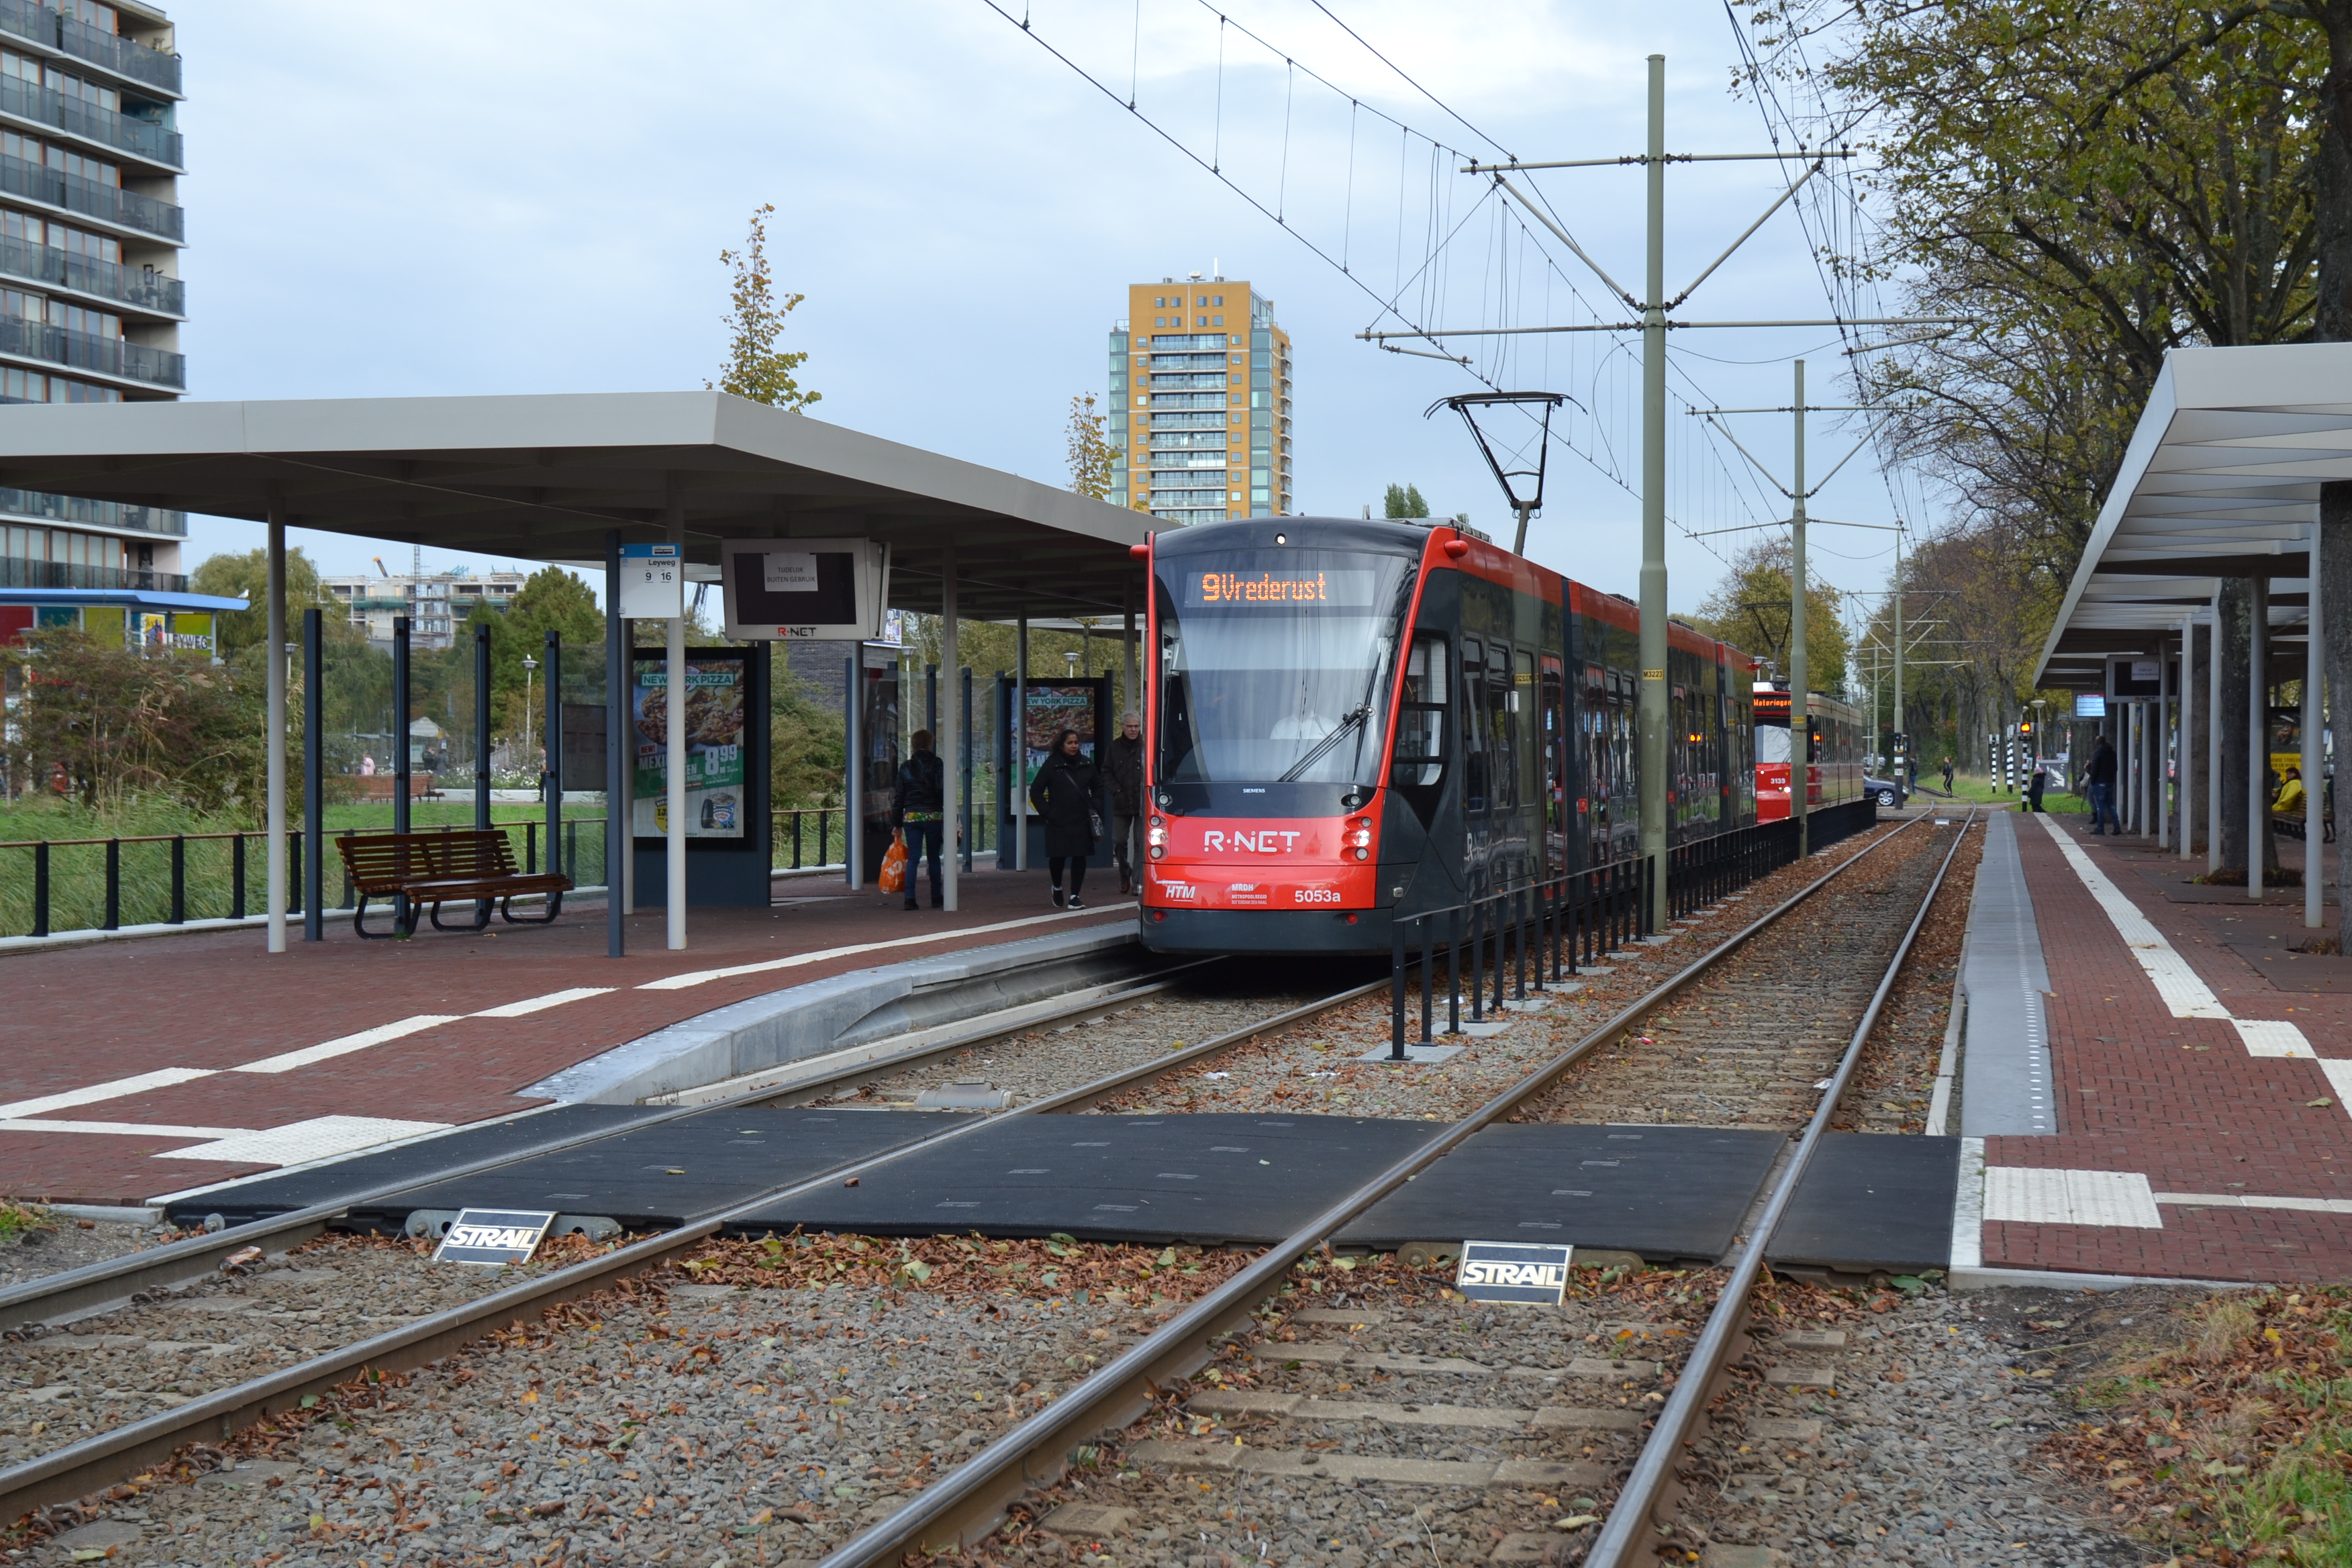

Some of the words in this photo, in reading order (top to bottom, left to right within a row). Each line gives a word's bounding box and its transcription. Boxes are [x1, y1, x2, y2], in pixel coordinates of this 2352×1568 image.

[648, 559, 676, 567] Leyweg
[645, 572, 652, 581] 9
[661, 572, 672, 581] 16
[1203, 574, 1220, 600] 9
[1222, 573, 1326, 600] Vrederust
[644, 676, 668, 684] NEW
[685, 676, 699, 684] RK
[701, 675, 732, 683] PIZZA
[639, 754, 668, 770] MEXI
[1166, 886, 1196, 898] HTM
[1295, 889, 1341, 902] 5053a
[447, 1227, 535, 1247] STRAIL
[1463, 1262, 1563, 1286] STRAIL
